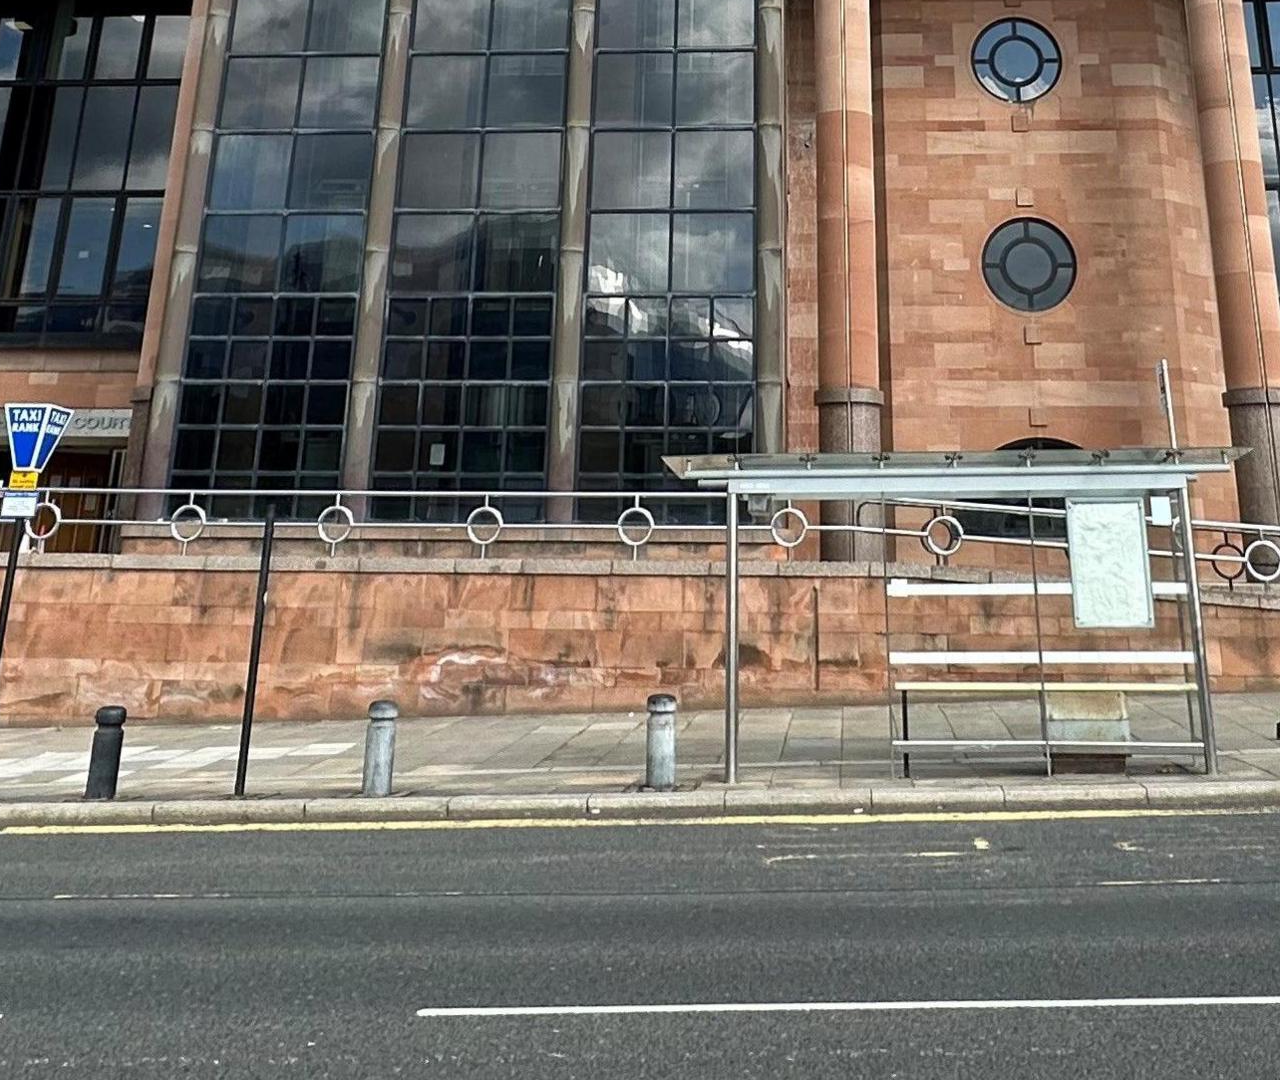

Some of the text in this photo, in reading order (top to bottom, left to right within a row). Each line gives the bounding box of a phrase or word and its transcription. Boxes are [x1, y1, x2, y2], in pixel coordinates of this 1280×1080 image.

[12, 409, 42, 421] TAXI
[11, 422, 40, 433] RANK
[73, 416, 132, 430] COURT
